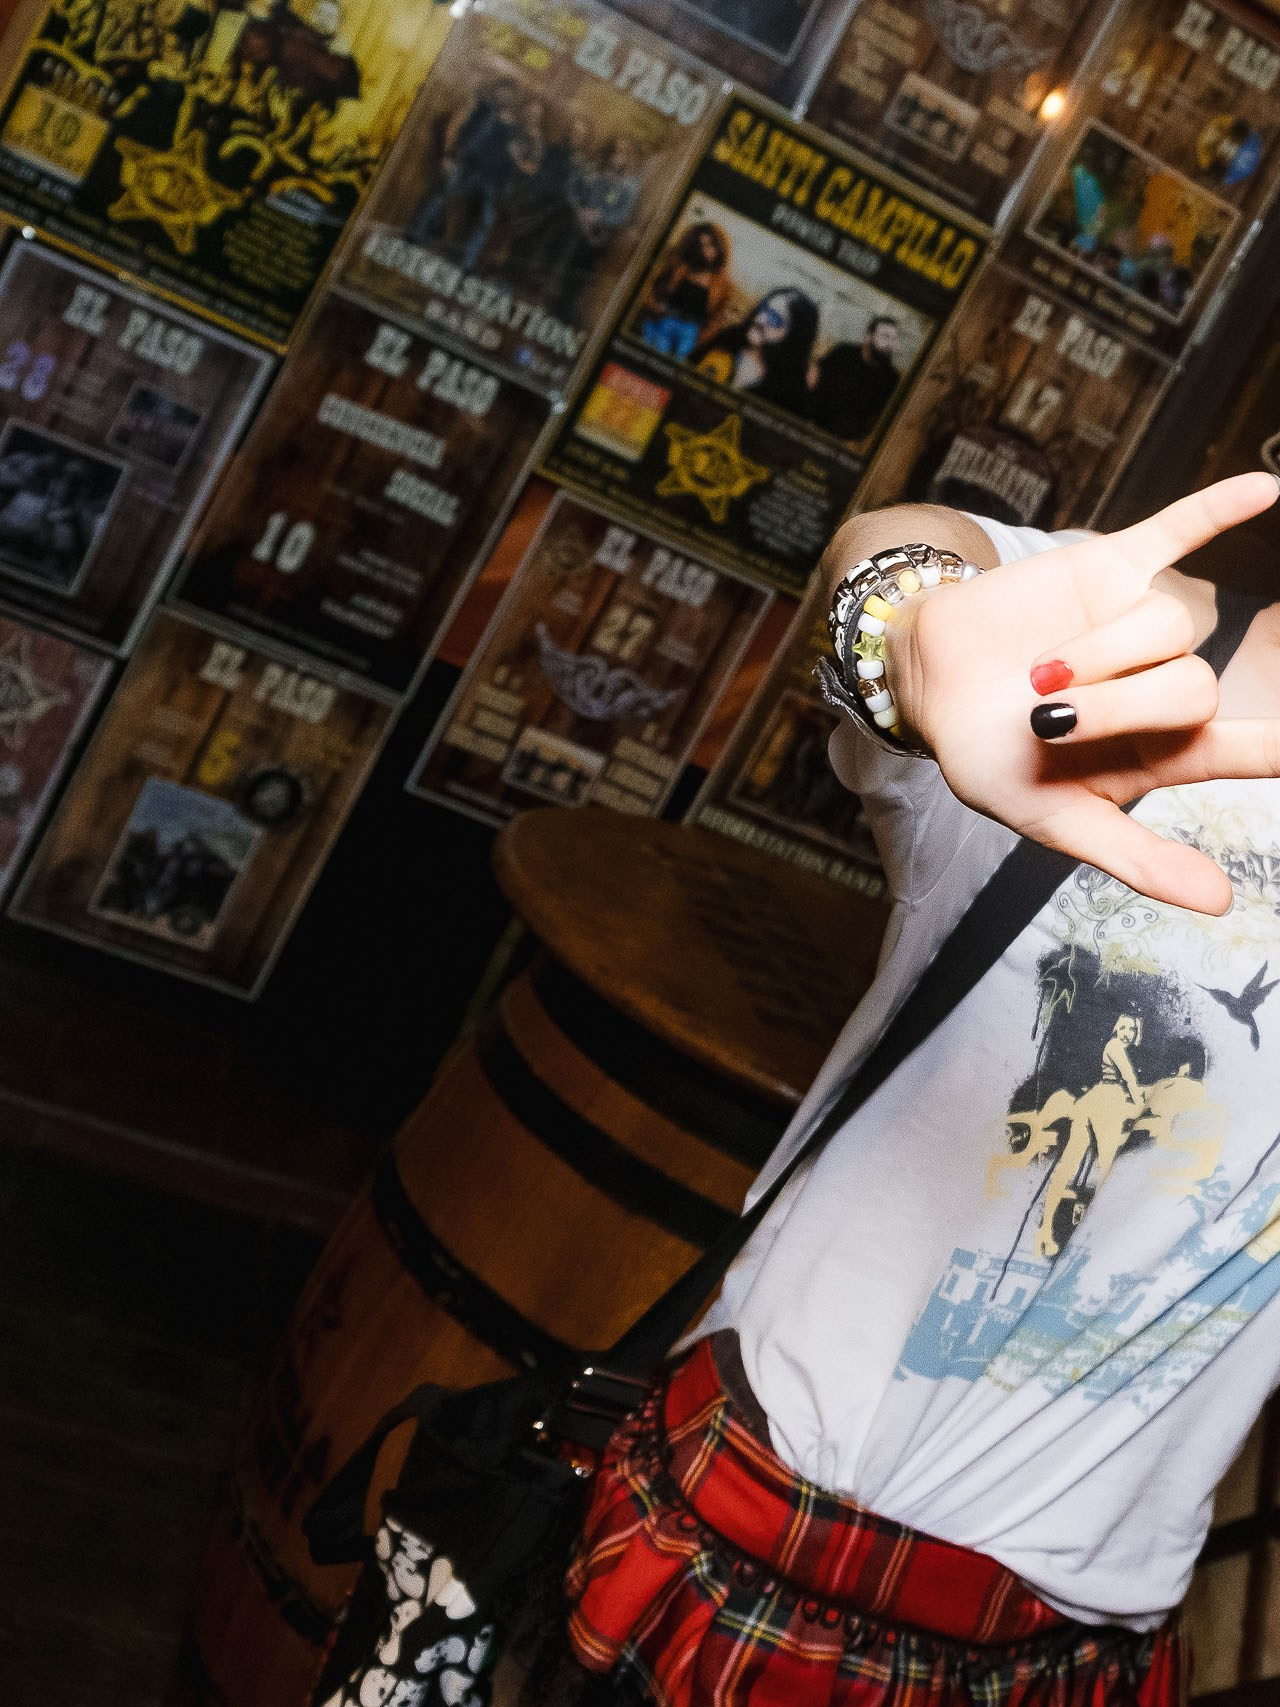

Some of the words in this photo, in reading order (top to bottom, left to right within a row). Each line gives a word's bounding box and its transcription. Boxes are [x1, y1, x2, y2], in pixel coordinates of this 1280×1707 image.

[1172, 3, 1218, 51] EL
[576, 26, 618, 79] EL
[611, 47, 706, 127] PASO
[712, 106, 827, 206] SANTI
[815, 164, 980, 292] CAMPILLO
[63, 282, 115, 336] EL
[117, 307, 205, 379] PASO
[364, 322, 414, 379] EL
[414, 348, 504, 418] PASO
[1011, 295, 1059, 342] EL
[1055, 313, 1128, 381] PASO
[252, 508, 318, 575] 10
[595, 526, 644, 573] EL
[640, 548, 719, 611] PASO
[201, 640, 251, 691] EL
[253, 661, 337, 726] PASO
